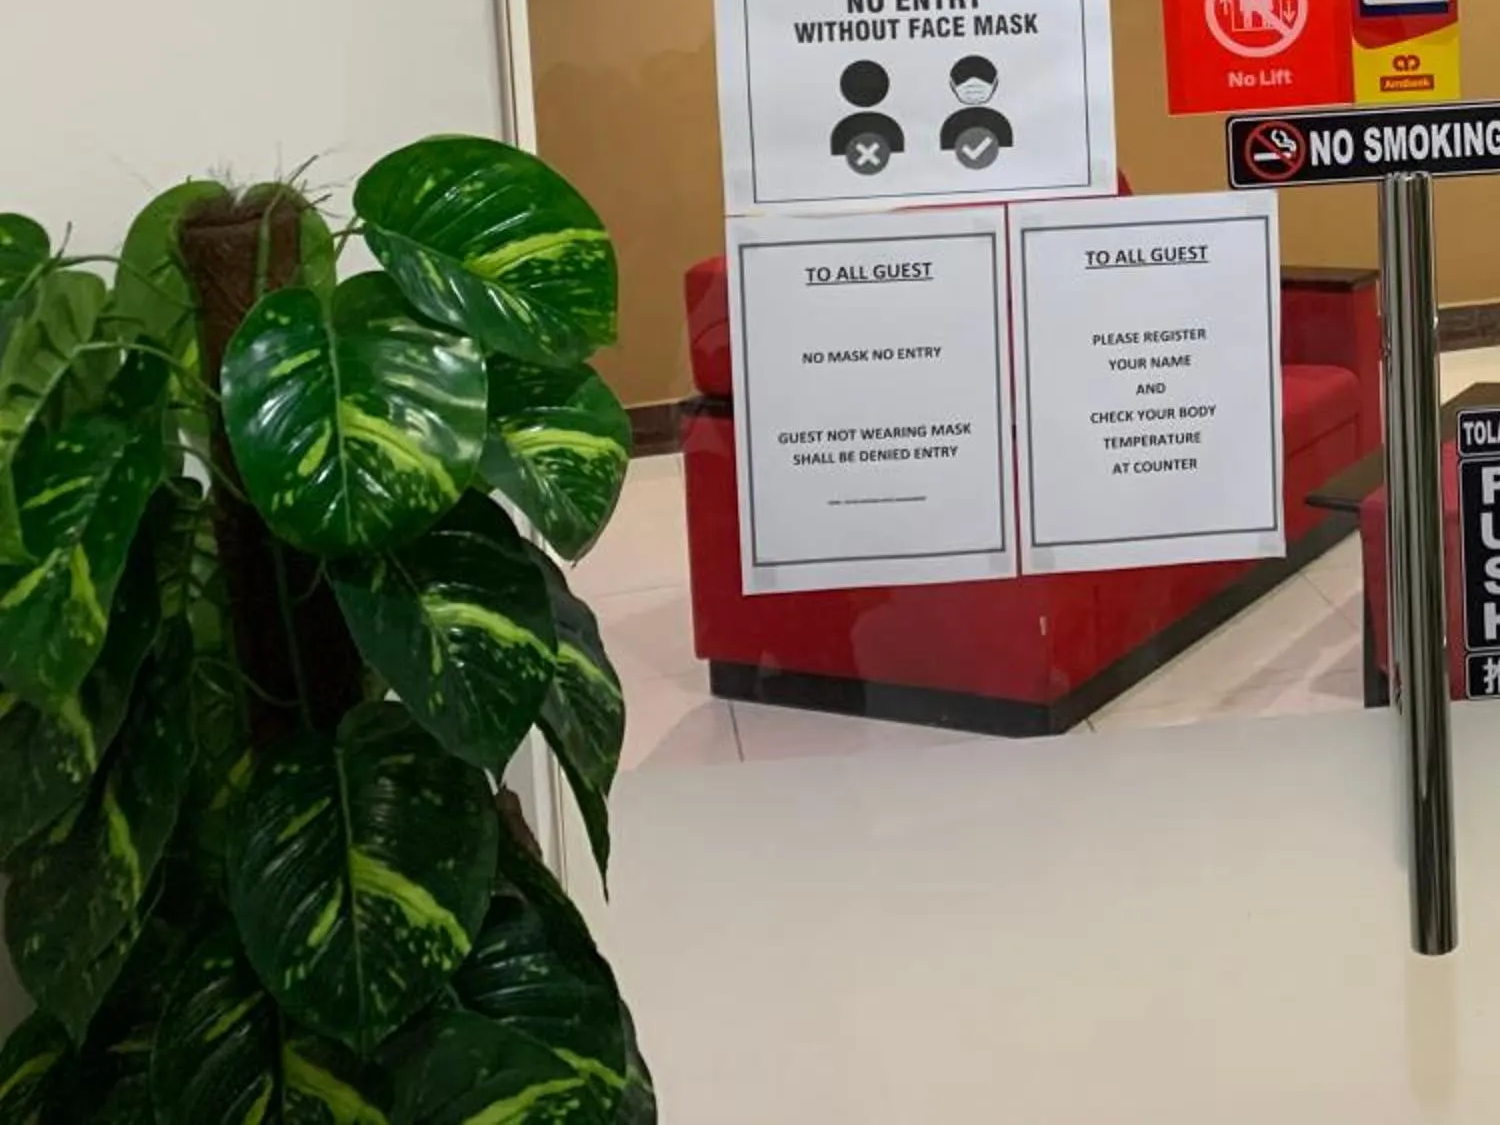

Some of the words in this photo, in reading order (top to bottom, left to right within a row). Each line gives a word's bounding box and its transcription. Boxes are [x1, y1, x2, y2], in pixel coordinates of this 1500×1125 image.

[794, 17, 900, 44] WITHOUT
[909, 15, 966, 39] FACE
[974, 13, 1039, 36] MASK
[1228, 71, 1257, 88] No
[1260, 69, 1292, 87] Lift
[1309, 128, 1354, 167] NO
[1085, 249, 1110, 267] TO
[1115, 248, 1145, 265] ALL
[1150, 244, 1209, 263] GUEST
[806, 266, 831, 283] TO
[836, 265, 869, 281] ALL
[873, 261, 933, 280] GUEST
[1092, 332, 1140, 347] PLEASE
[1143, 327, 1207, 345] REGISTER
[802, 351, 824, 364] NO
[827, 349, 869, 363] MASK
[872, 347, 894, 361] NO
[897, 346, 942, 360] ENTRY
[1108, 357, 1147, 372] YOUR
[1150, 354, 1192, 369] NAME
[1135, 382, 1166, 396] AND
[1090, 410, 1133, 425] CHECK
[1137, 407, 1176, 422] YOUR
[1178, 404, 1217, 420] BODY
[777, 430, 825, 445] GUEST
[827, 428, 858, 442] NOT
[860, 425, 927, 440] WEARING
[930, 422, 972, 437] MASK
[1103, 431, 1202, 450] TEMPERATURE
[793, 452, 835, 466] SHALL
[839, 450, 855, 464] BE
[859, 448, 911, 463] DENIED
[913, 445, 959, 460] ENTRY
[1112, 461, 1130, 475] AT
[1133, 458, 1198, 474] COUNTER
